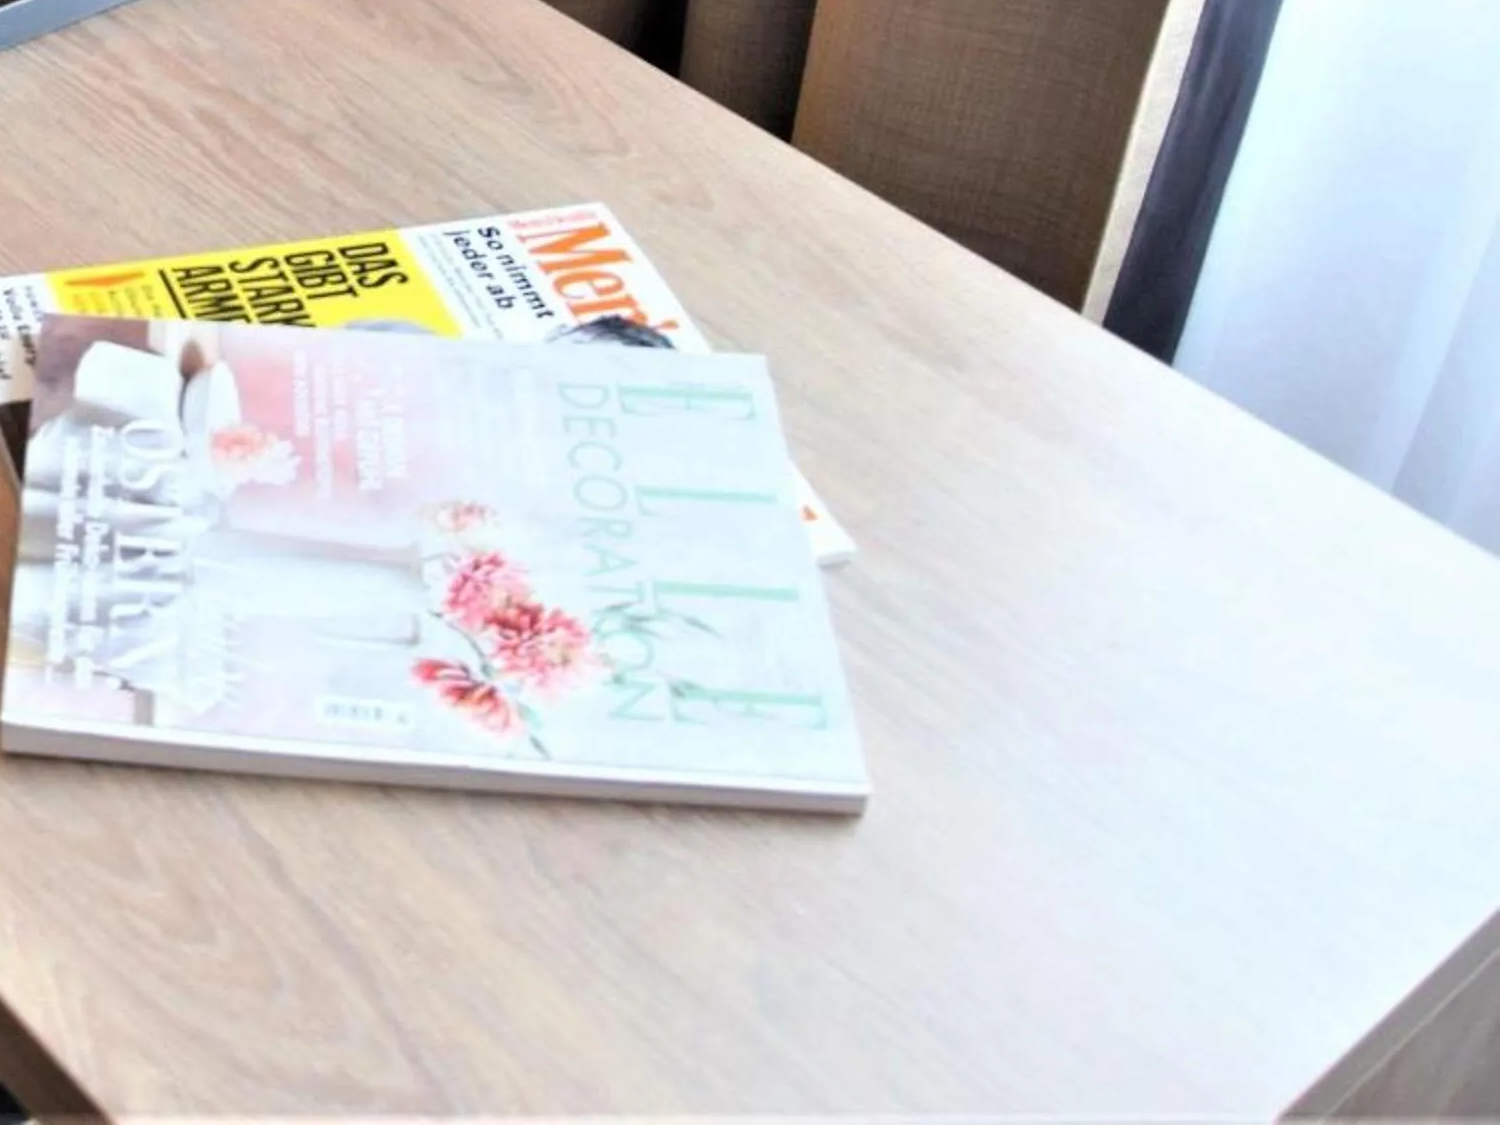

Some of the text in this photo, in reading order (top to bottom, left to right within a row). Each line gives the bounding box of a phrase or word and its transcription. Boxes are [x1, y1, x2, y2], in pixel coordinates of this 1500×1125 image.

[284, 249, 360, 300] GIBT
[337, 242, 409, 289] DAS
[442, 229, 495, 281] jeder
[487, 283, 517, 311] ab
[477, 226, 503, 252] So
[496, 251, 555, 320] nimmt
[617, 382, 827, 729] ELLE
